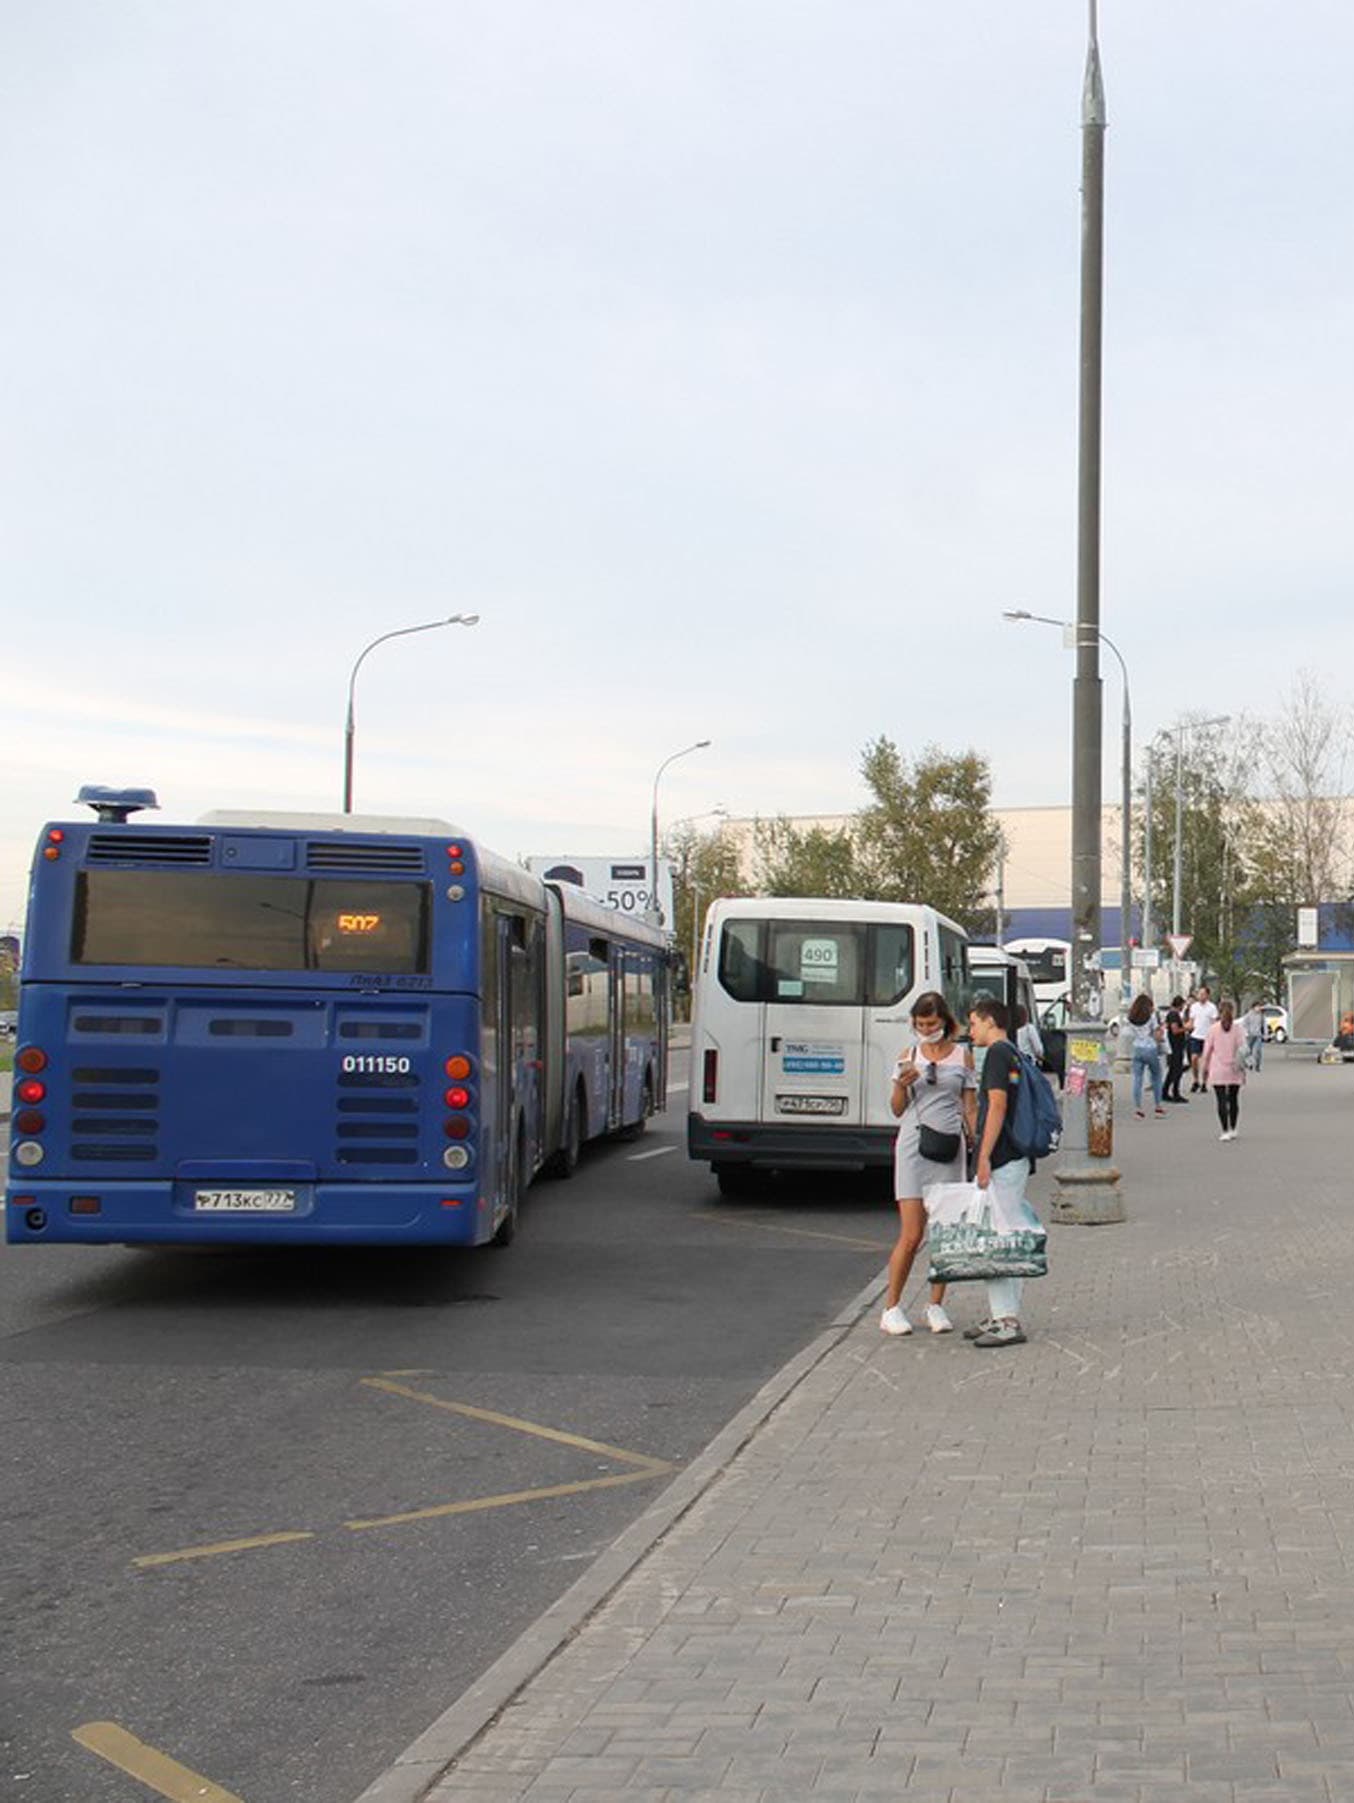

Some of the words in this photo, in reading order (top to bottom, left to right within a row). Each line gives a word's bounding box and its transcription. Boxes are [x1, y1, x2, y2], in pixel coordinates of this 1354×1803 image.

[339, 913, 381, 932] 507
[804, 947, 832, 961] 490
[343, 1056, 410, 1073] 011150
